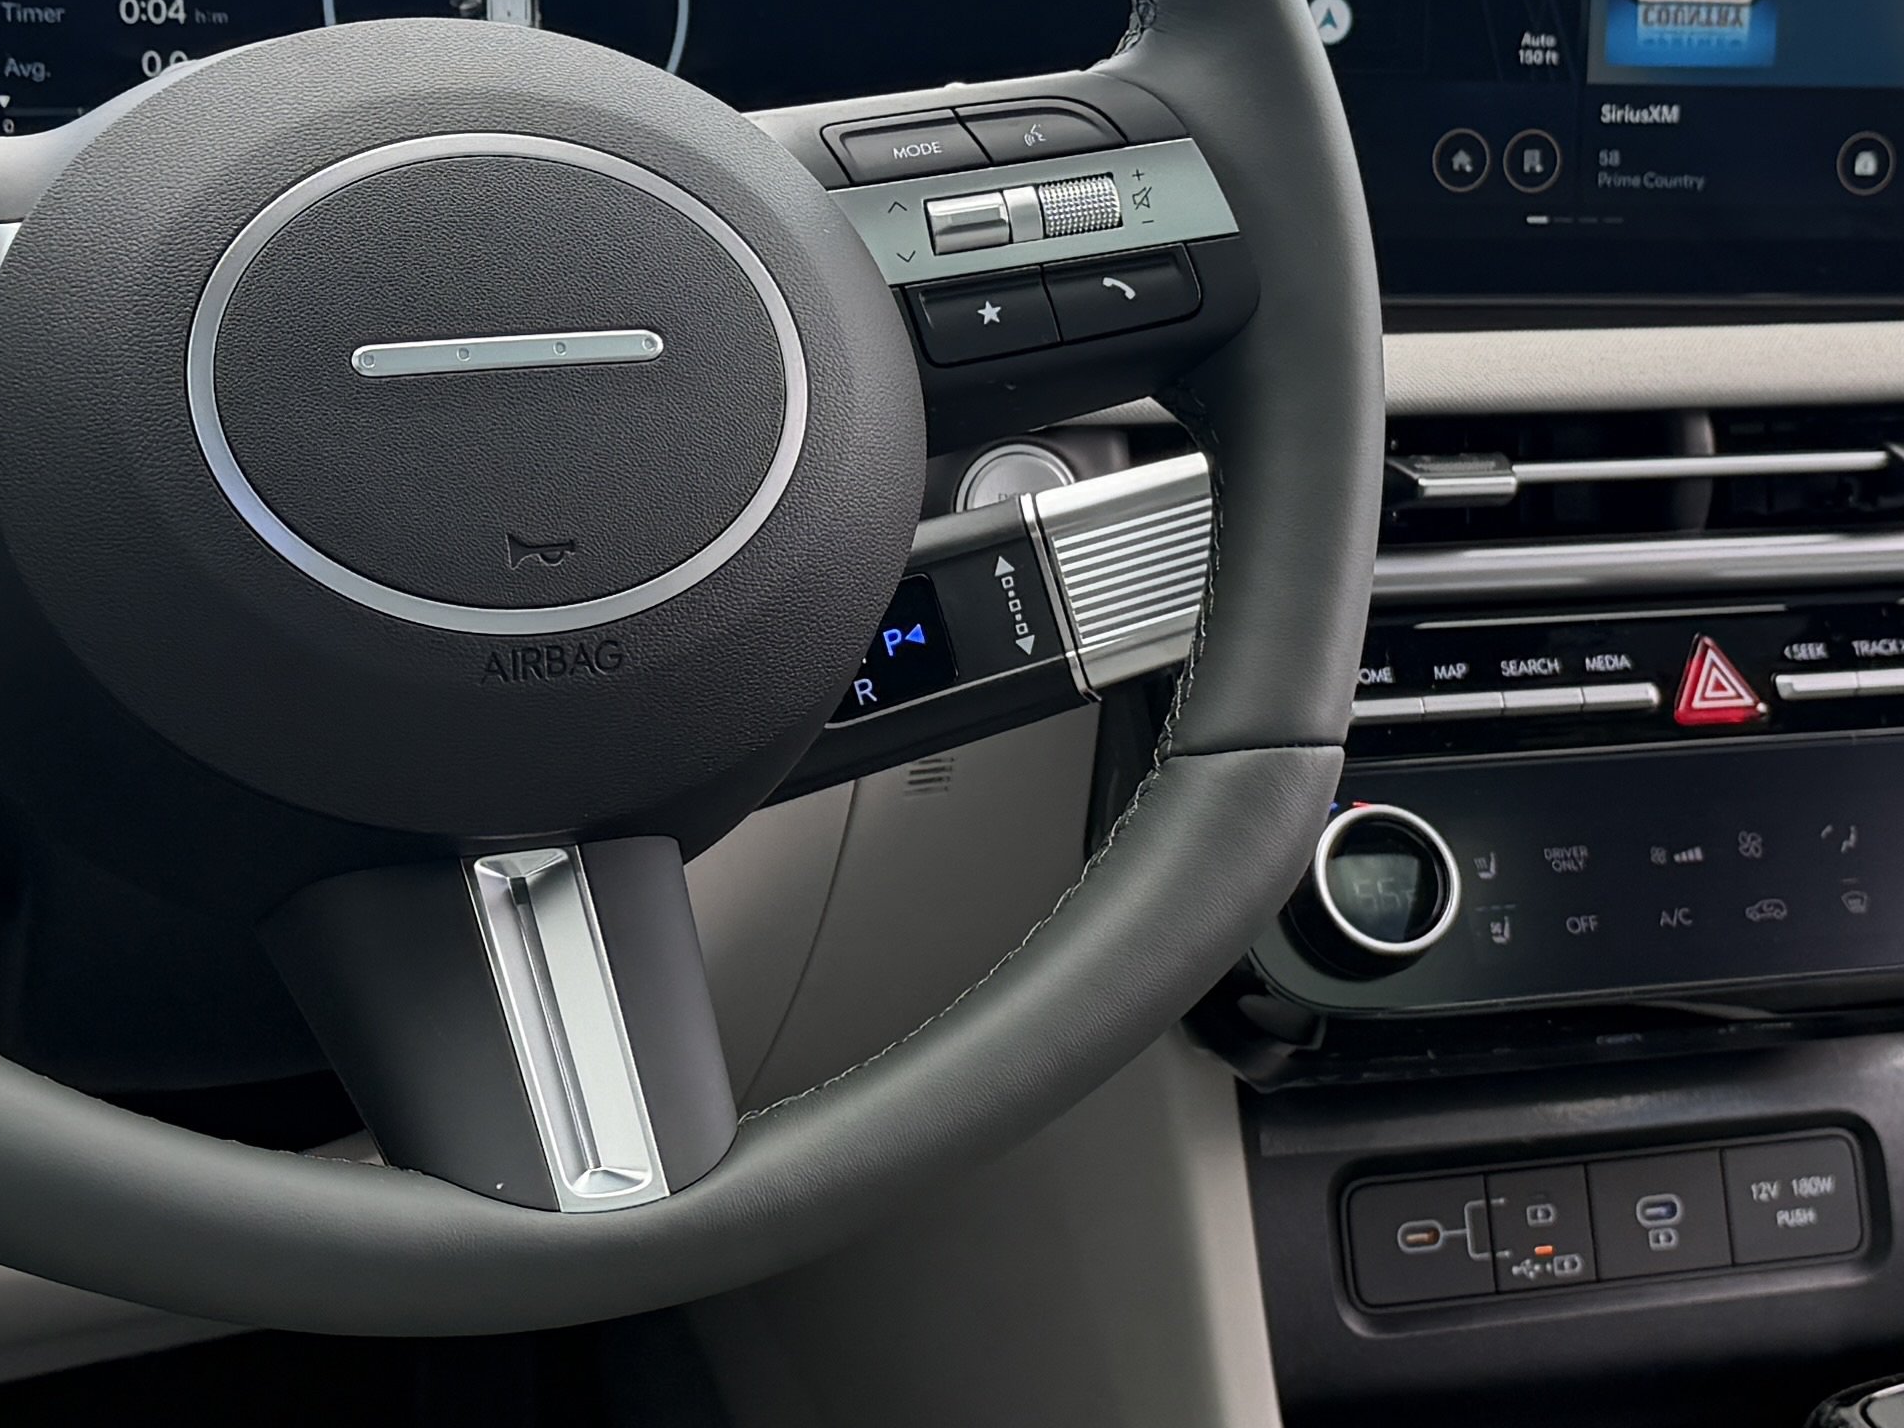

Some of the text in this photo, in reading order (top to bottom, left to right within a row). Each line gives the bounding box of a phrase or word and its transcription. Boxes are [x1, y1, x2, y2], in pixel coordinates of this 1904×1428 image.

[0, 2, 66, 25] Timer
[4, 56, 51, 82] Avg.
[1599, 103, 1681, 126] SiriusXM
[892, 140, 943, 160] MODE
[1598, 172, 1641, 192] Prime
[882, 629, 904, 657] P
[481, 638, 624, 687] AIRBAG
[1433, 662, 1470, 681] MAP
[1500, 657, 1562, 678] SEARCH
[1585, 653, 1633, 672] MEDIA
[1357, 667, 1394, 685] OME
[852, 677, 879, 707] R
[1543, 845, 1589, 861] DRIVER
[1551, 857, 1585, 873] ONLY
[1565, 914, 1599, 935] OFF
[1658, 907, 1694, 929] A/C
